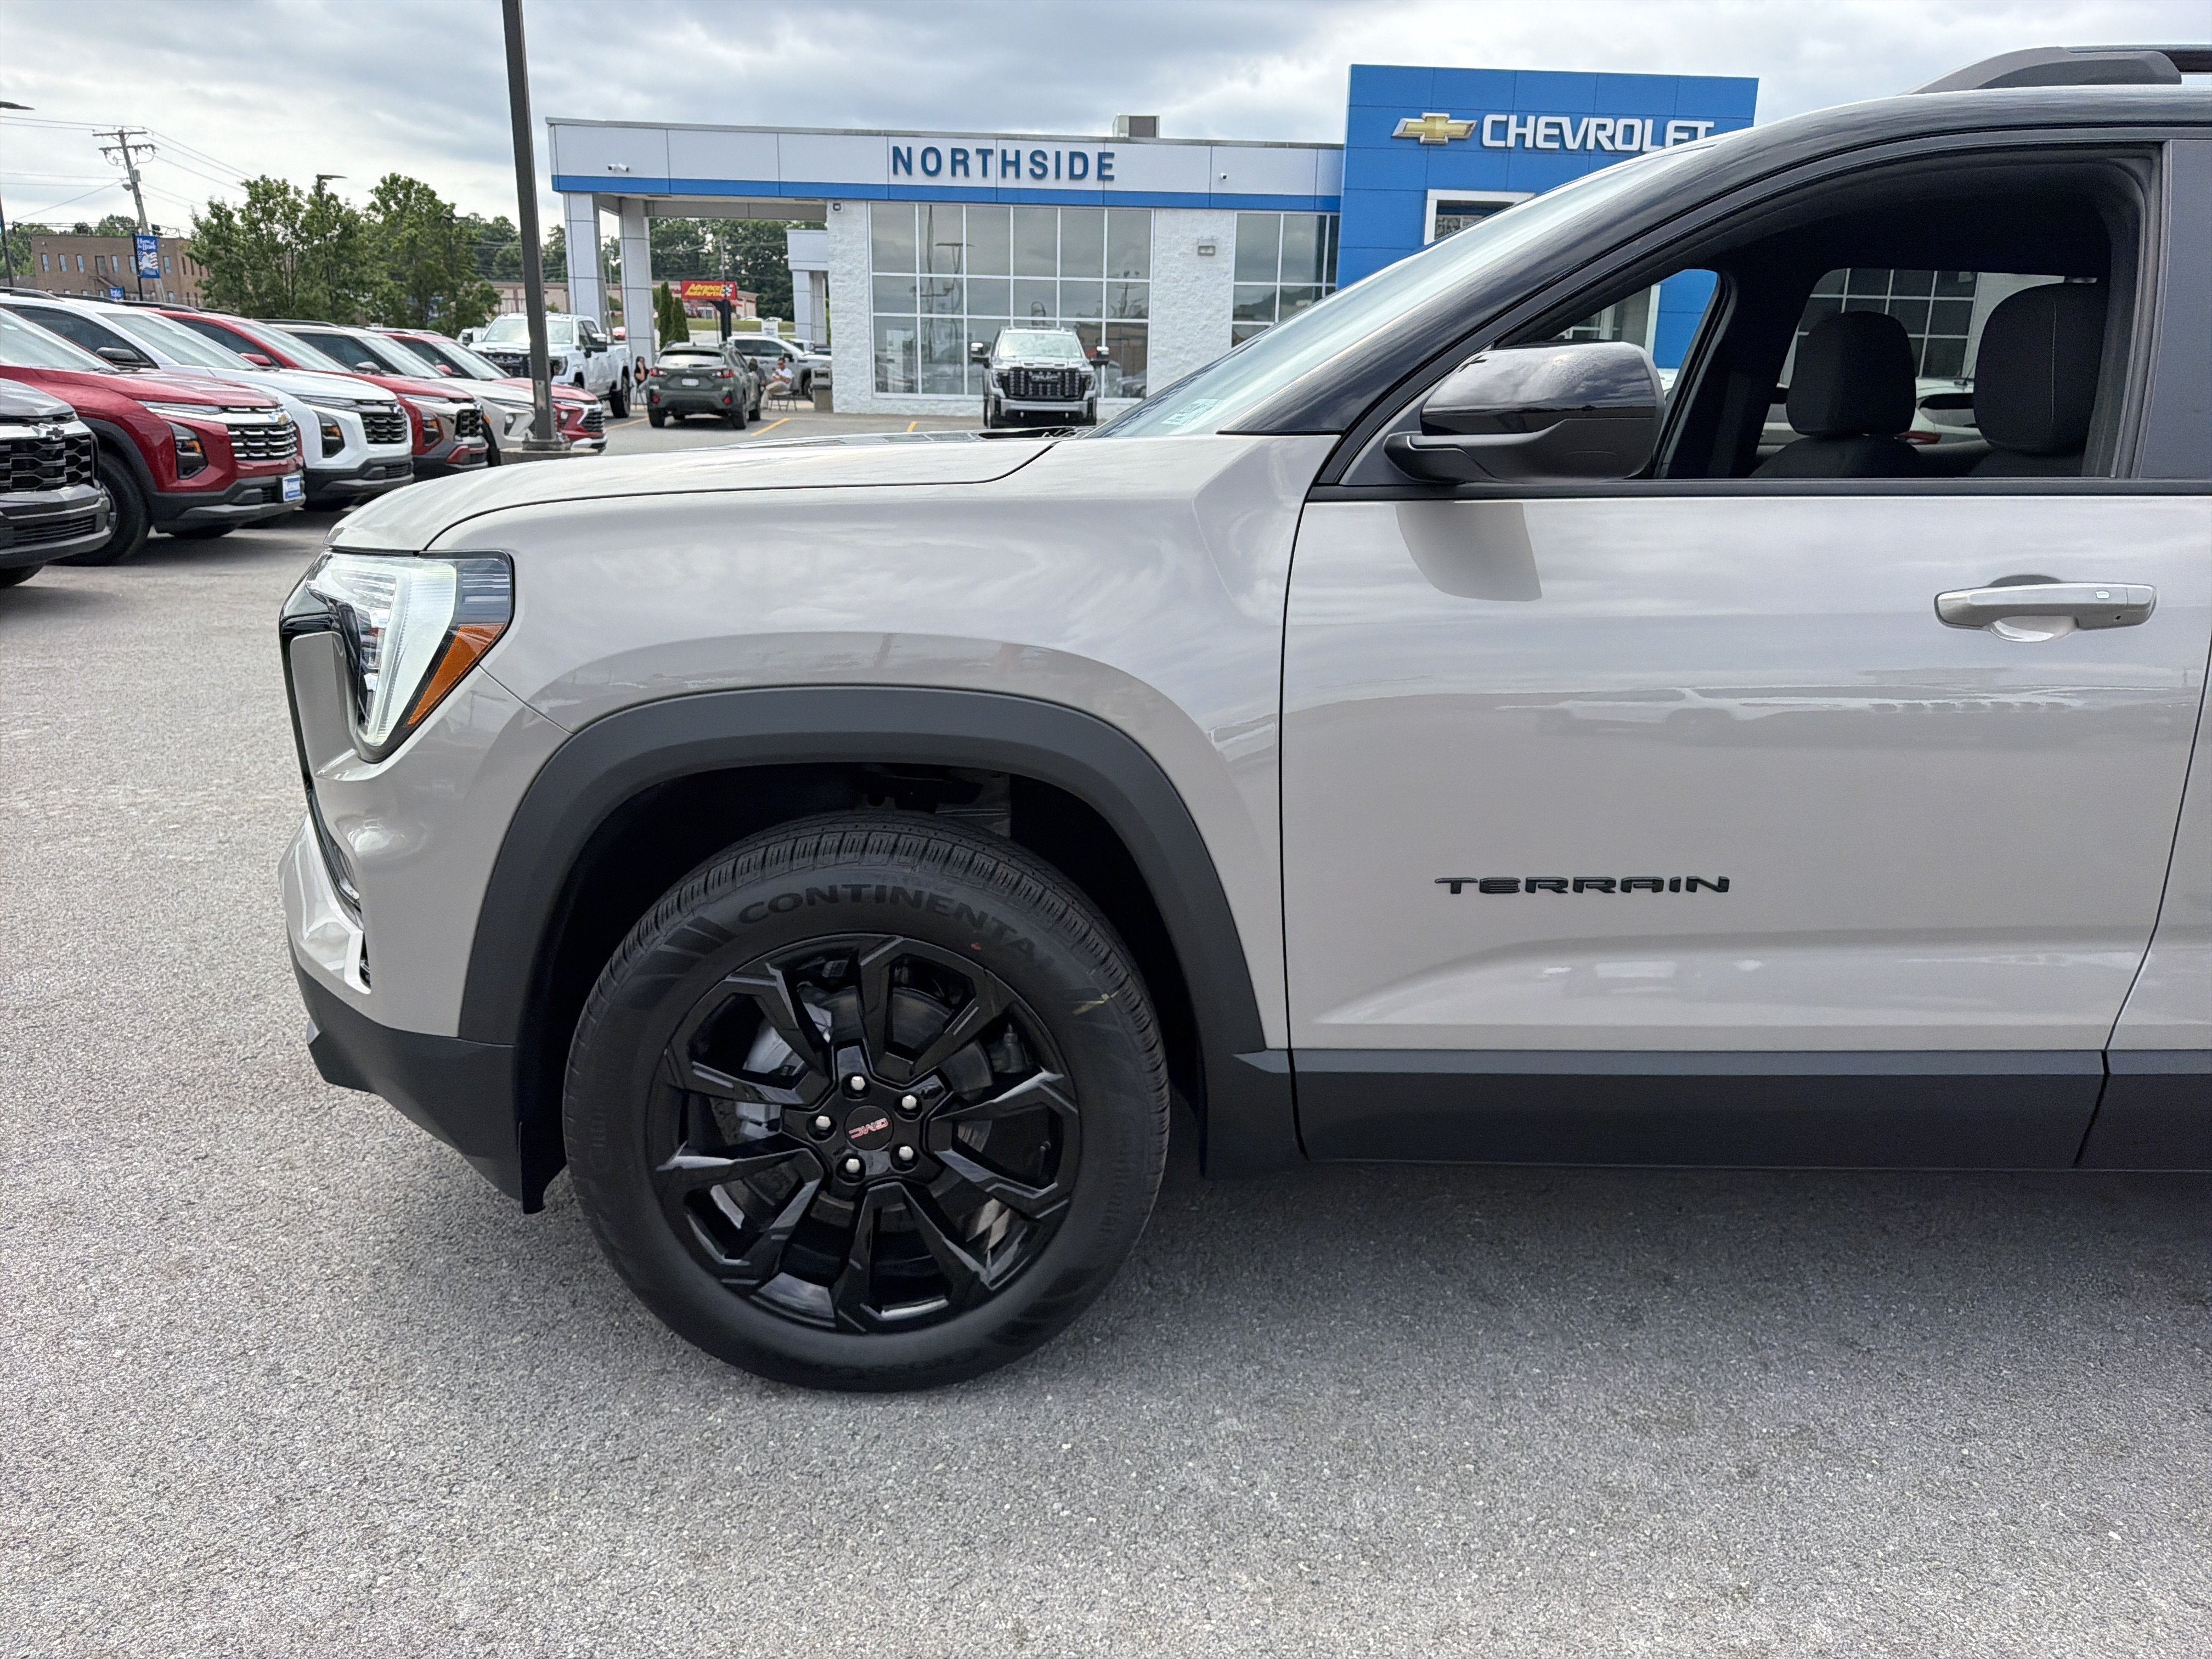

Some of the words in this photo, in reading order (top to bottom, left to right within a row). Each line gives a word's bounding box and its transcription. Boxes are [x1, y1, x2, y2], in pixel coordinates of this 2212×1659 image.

[1482, 114, 1714, 151] CHEVROLET
[893, 146, 1115, 180] NORTHSIDE
[1435, 876, 1730, 894] TERRAIN
[849, 1118, 889, 1139] GMC
